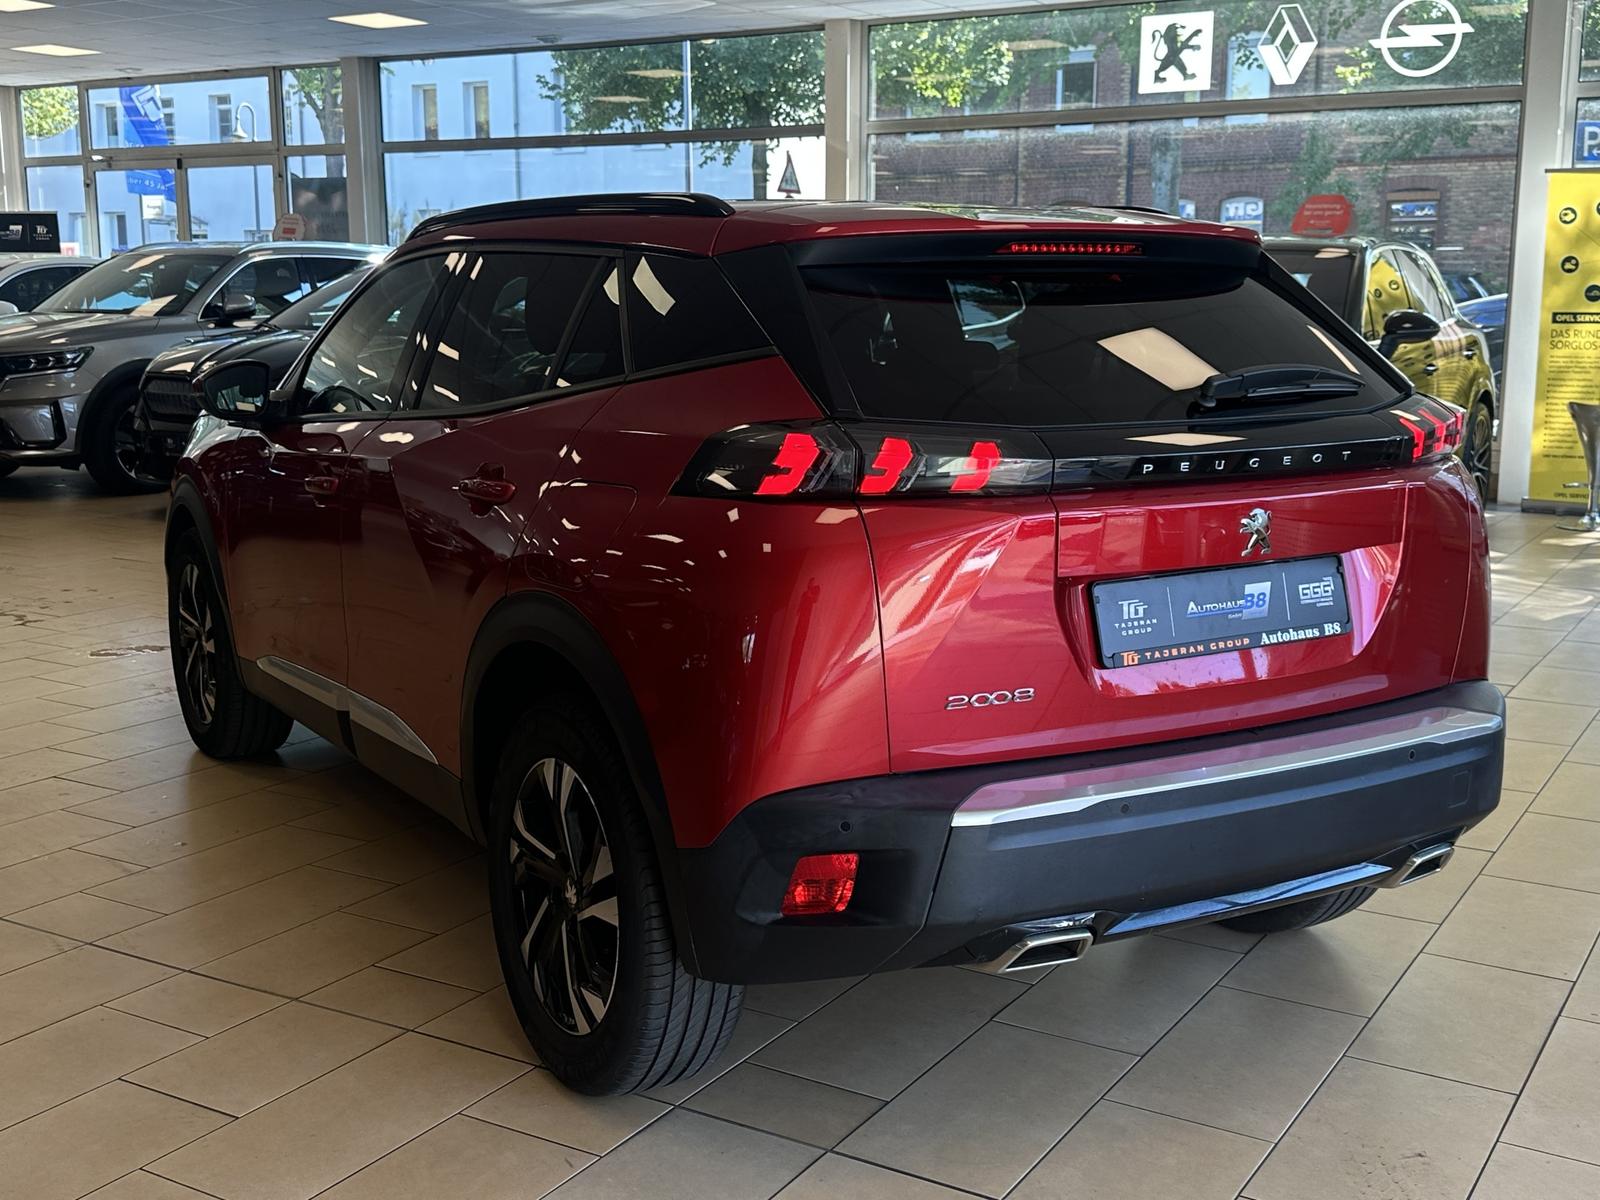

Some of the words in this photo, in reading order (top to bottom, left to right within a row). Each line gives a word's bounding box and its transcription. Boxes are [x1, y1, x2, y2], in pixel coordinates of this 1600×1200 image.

[1555, 314, 1575, 322] OPEL
[1550, 329, 1570, 339] DAS
[1142, 450, 1352, 475] PEUGEOT
[1114, 618, 1158, 630] TAJERAN
[1121, 626, 1153, 637] GROUP
[1145, 644, 1205, 660] TAJERAN
[1209, 637, 1251, 650] GROUP
[1260, 626, 1321, 645] Autohaus
[1323, 622, 1342, 635] B8
[945, 687, 1035, 711] 2008
